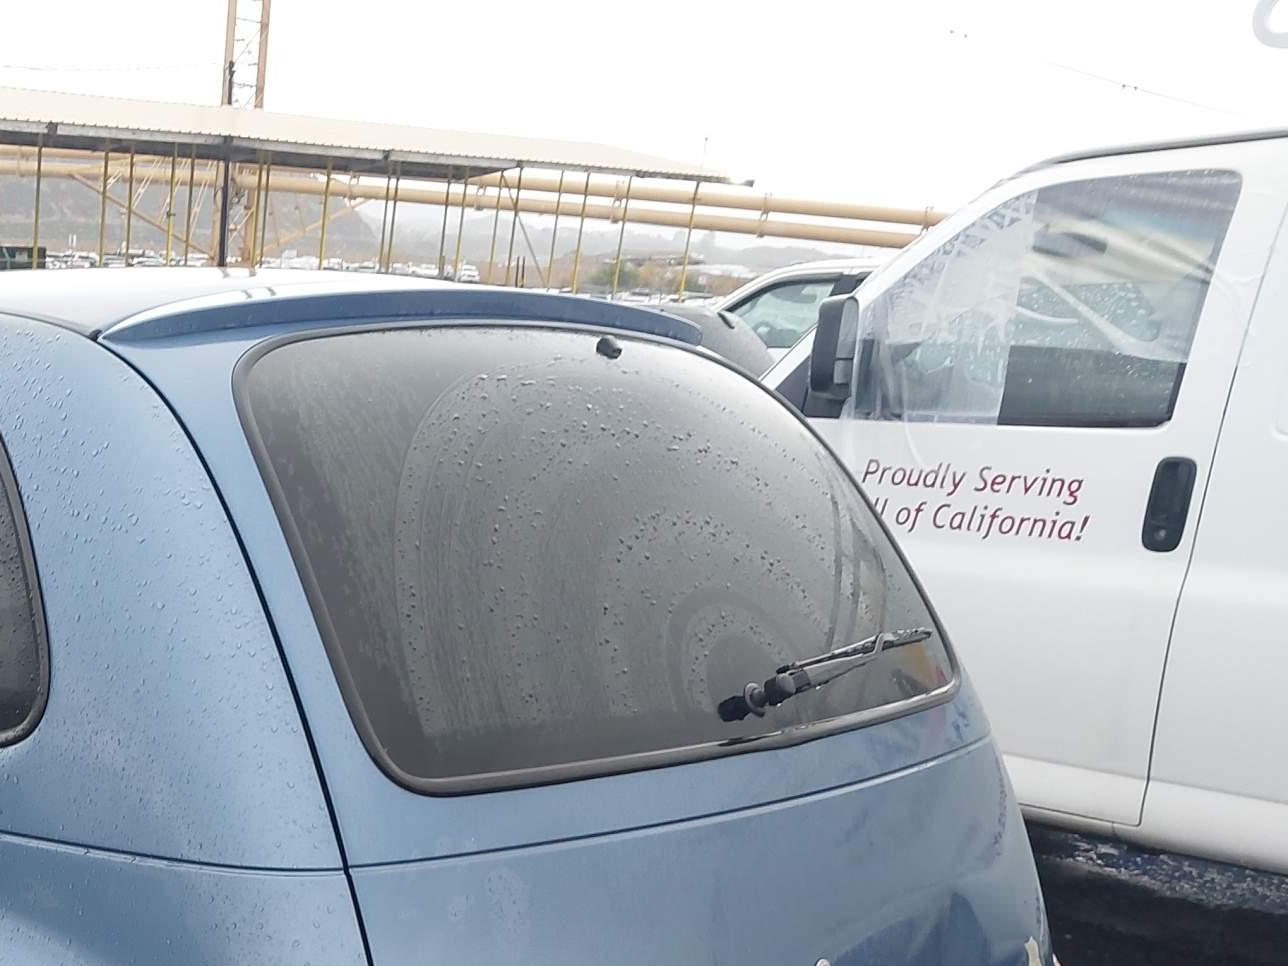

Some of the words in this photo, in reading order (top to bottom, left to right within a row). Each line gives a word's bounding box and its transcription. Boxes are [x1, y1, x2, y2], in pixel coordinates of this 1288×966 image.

[862, 459, 966, 496] Proudly
[974, 466, 1083, 505] Serving
[872, 497, 888, 519] ll
[895, 501, 928, 533] of
[932, 503, 1090, 541] California!
